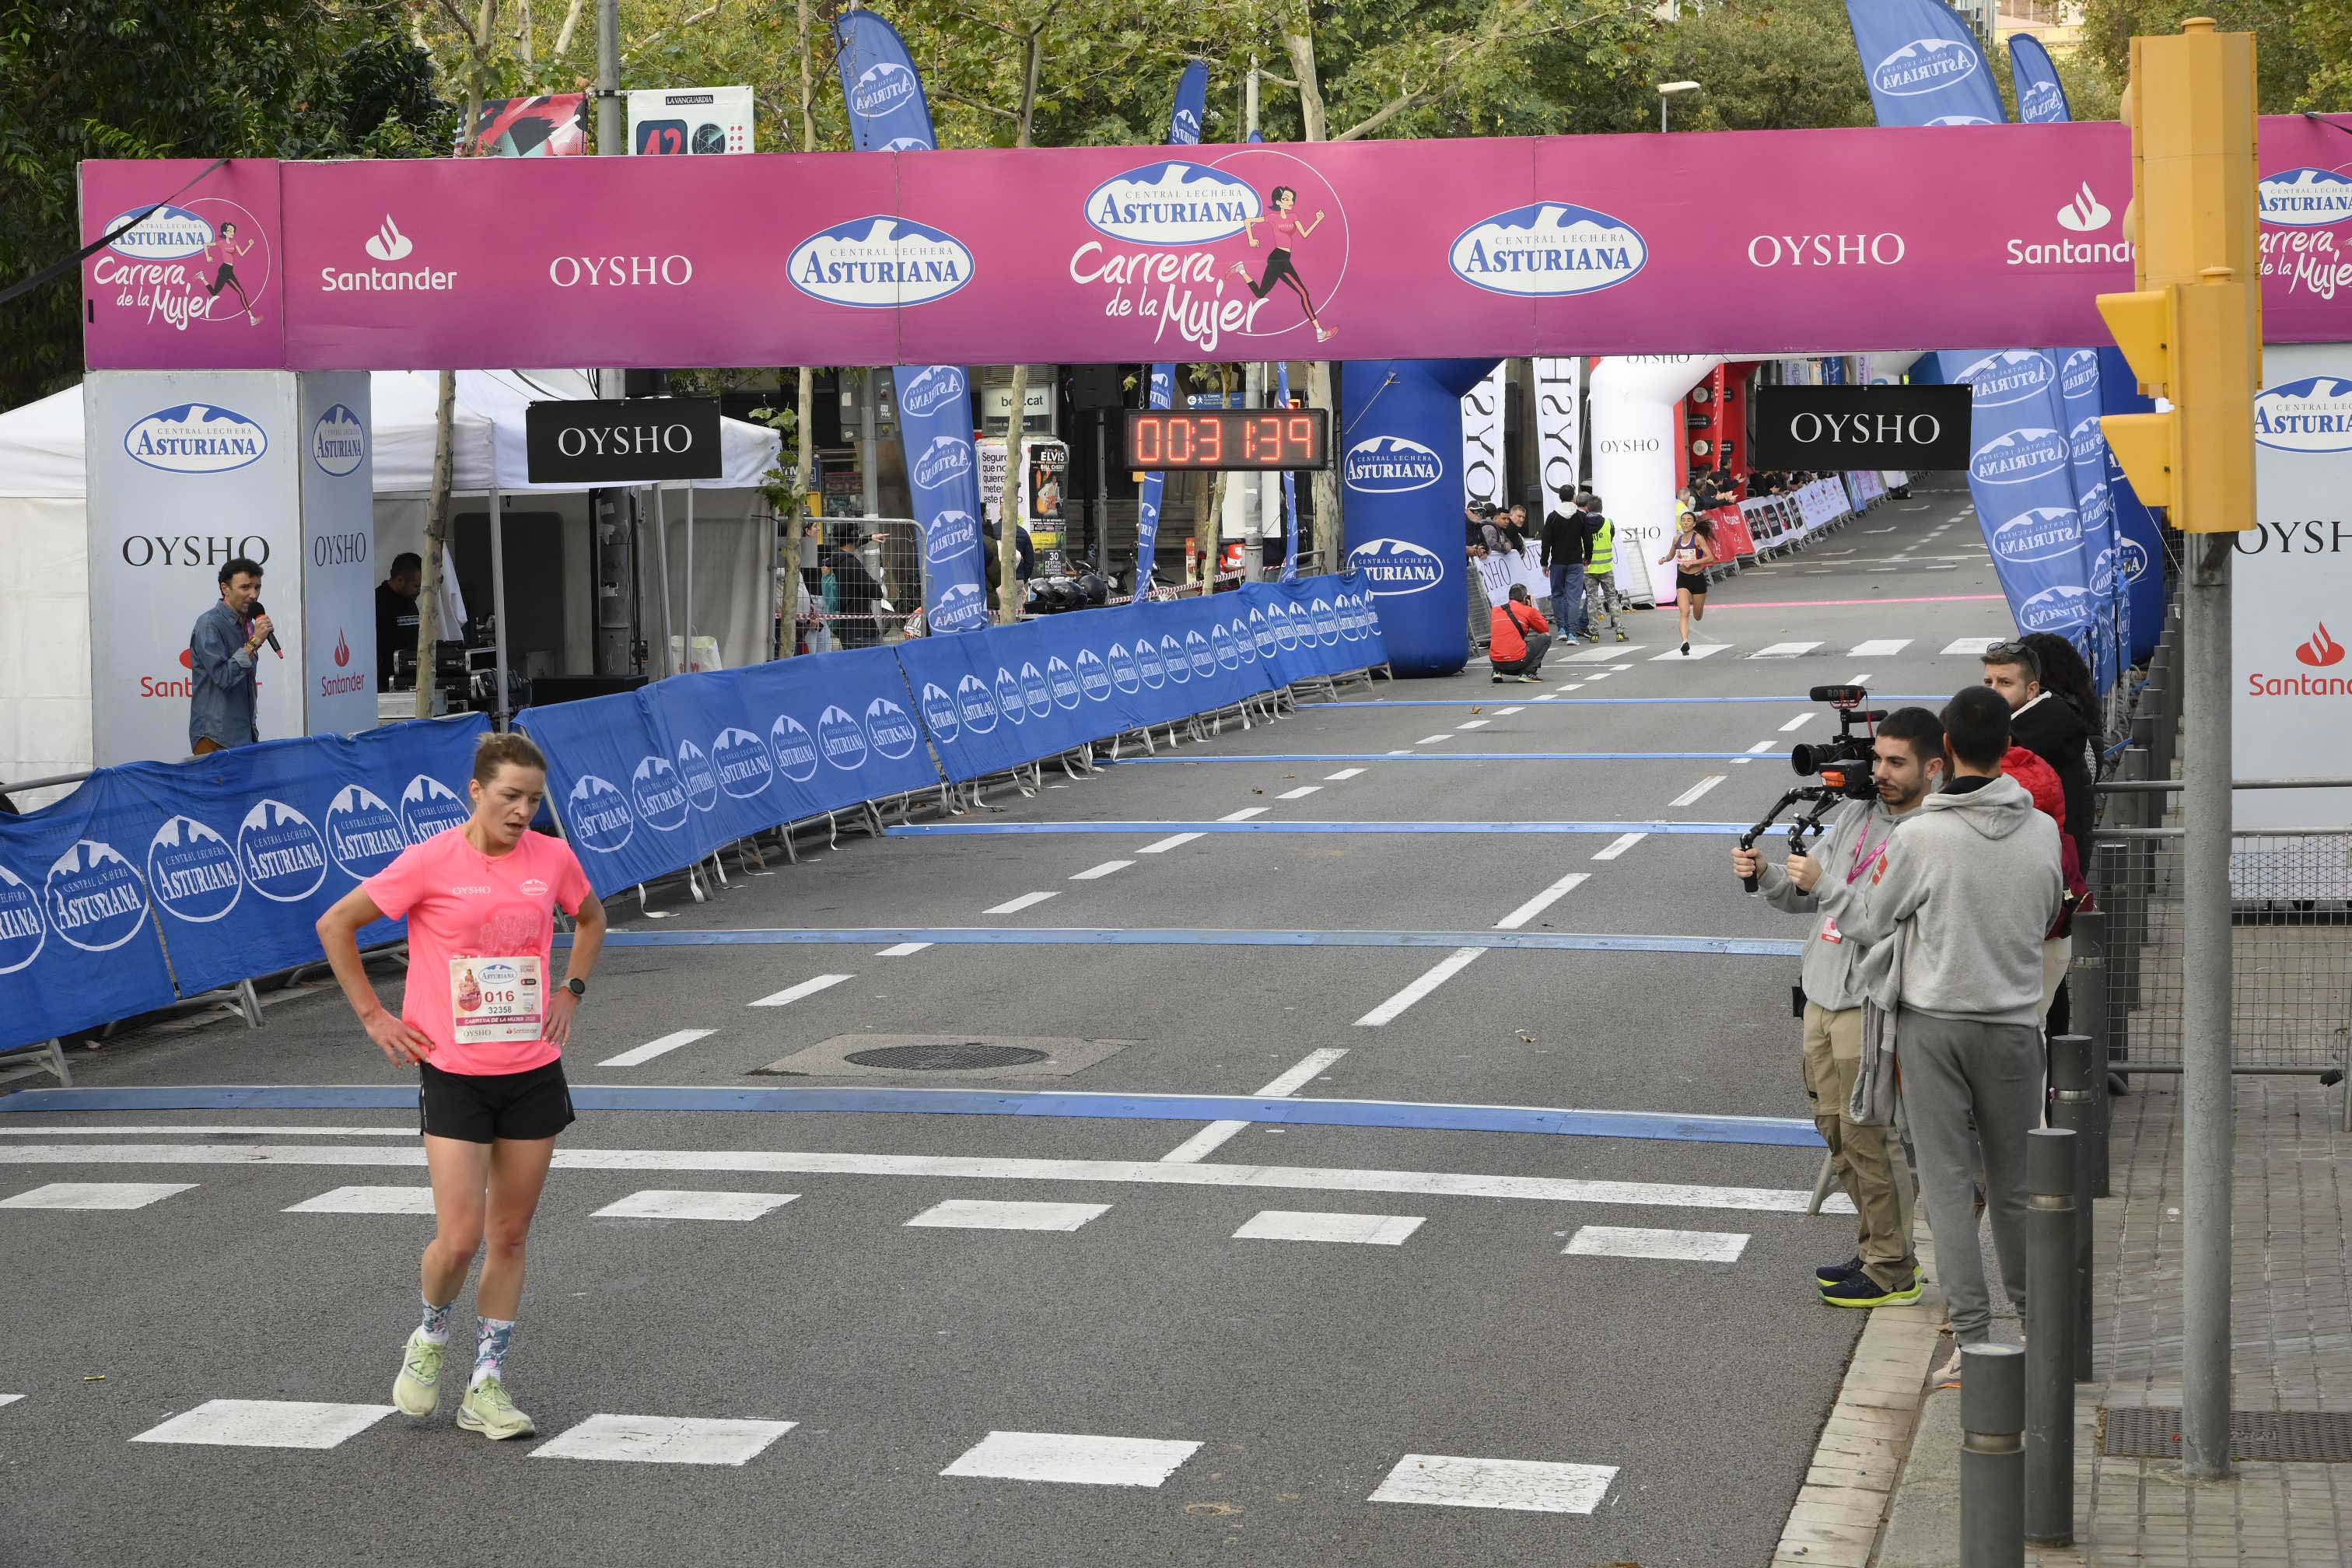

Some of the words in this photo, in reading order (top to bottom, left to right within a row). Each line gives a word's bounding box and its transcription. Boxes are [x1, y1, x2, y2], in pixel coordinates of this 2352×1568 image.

[1125, 189, 1181, 199] CENTRAL
[1187, 188, 1243, 198] LECHERA
[1098, 193, 1247, 224] ASTURIANA
[830, 248, 888, 257] CENTRAL
[894, 247, 954, 256] LECHERA
[1496, 235, 1556, 245] CENTRAL
[1563, 233, 1625, 243] LECHERA
[1748, 233, 1906, 268] OYSHO
[2006, 238, 2136, 265] Santand
[2259, 230, 2334, 254] arrera
[801, 250, 960, 284] ASTURIANA
[1069, 241, 1215, 285] Carrera
[1465, 239, 1632, 273] ASTURIANA
[93, 256, 186, 285] Carrera
[322, 265, 457, 292] Santander
[549, 254, 693, 287] OYSHO
[2278, 255, 2291, 275] la
[2289, 249, 2352, 299] Muje
[117, 286, 134, 306] de
[138, 288, 149, 306] la
[147, 283, 220, 331] Mujer
[1105, 287, 1132, 317] de
[1139, 286, 1157, 317] la
[1154, 278, 1269, 352] Mujer
[558, 424, 692, 457] OYSHO
[1138, 418, 1311, 462] 00:31:39
[1790, 412, 1941, 444] OYSHO
[136, 429, 257, 456] ASTURIANA
[317, 430, 362, 459] ASTURIANA
[1041, 452, 1064, 461] ELVIS
[1601, 438, 1659, 453] OYSHO
[982, 465, 995, 474] que
[1347, 458, 1436, 481] ASTURIANA
[984, 495, 998, 503] este
[122, 535, 271, 567] OYSHO
[314, 532, 366, 567] OYSHO
[321, 673, 366, 698] Santander
[823, 732, 866, 756] ASTURIANA
[716, 755, 771, 785] ASTURIANA
[254, 835, 282, 848] CENTRAL
[283, 828, 312, 841] LECHERA
[341, 818, 367, 831] CENTRAL
[166, 852, 195, 866] CENTRAL
[197, 847, 226, 859] LECHERA
[333, 824, 404, 861] ASTURIANA
[246, 842, 324, 881] ASTURIANA
[157, 860, 238, 901] ASTURIANA
[453, 886, 491, 895] OYSHO
[485, 990, 514, 1003] 016
[464, 1029, 492, 1038] OYSHO
